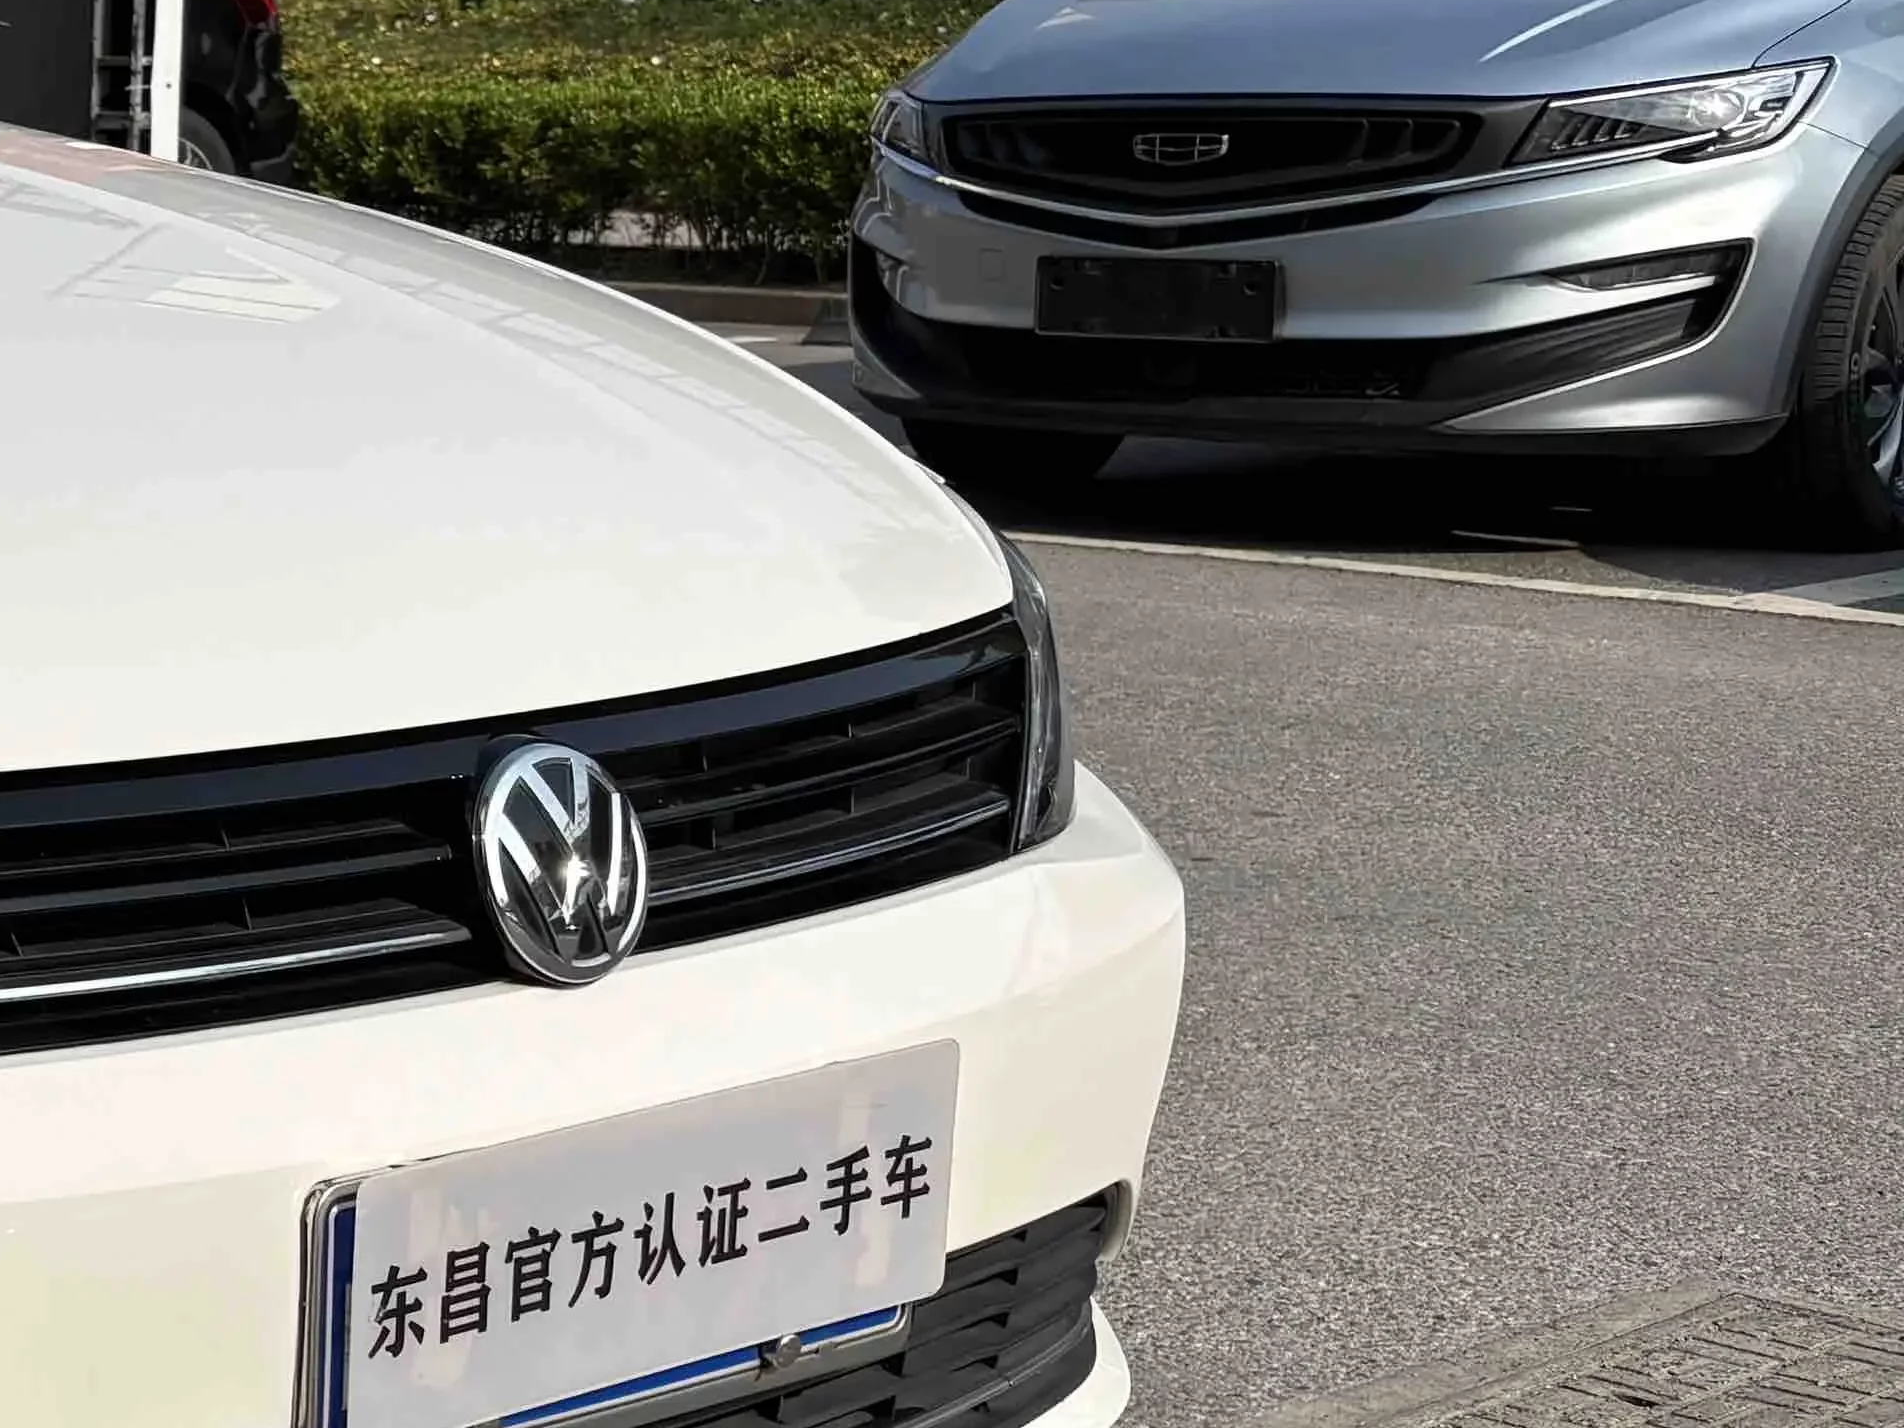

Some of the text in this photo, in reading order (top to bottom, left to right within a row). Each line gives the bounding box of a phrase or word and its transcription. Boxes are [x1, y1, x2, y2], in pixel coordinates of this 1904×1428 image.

[368, 1134, 933, 1360] 东昌官方认证二手车
